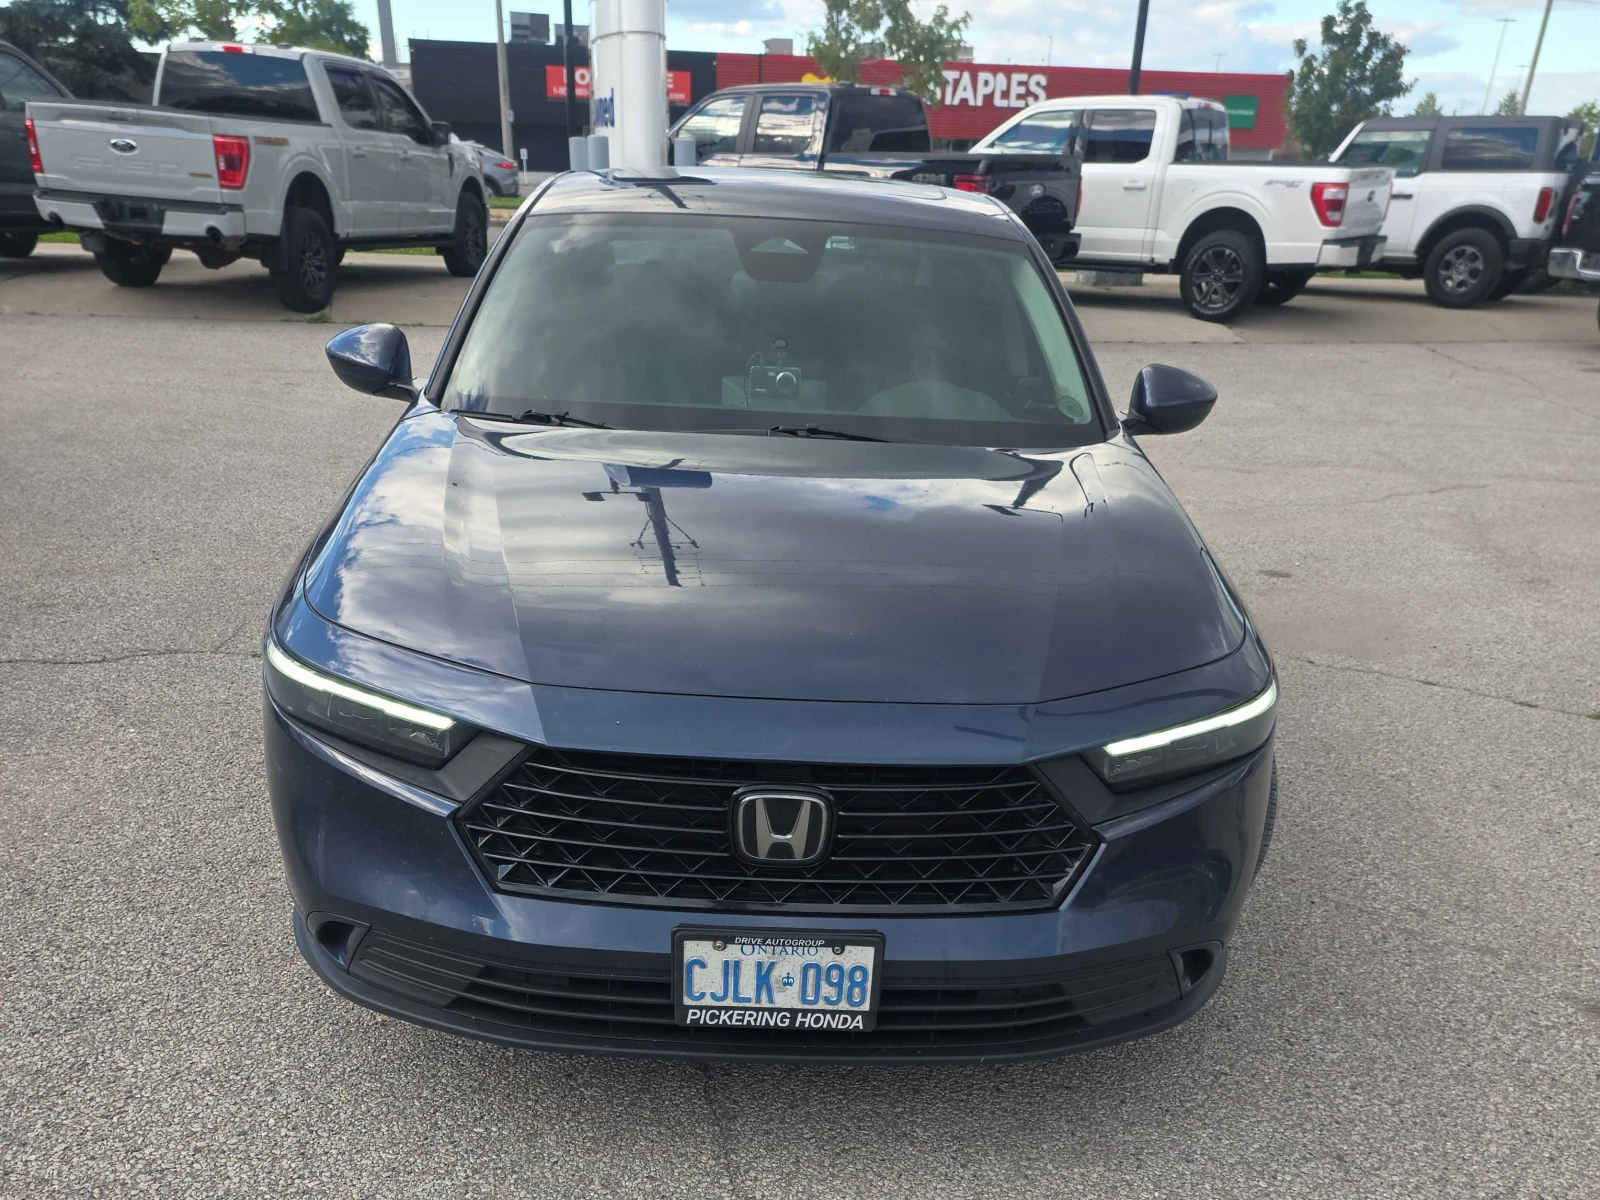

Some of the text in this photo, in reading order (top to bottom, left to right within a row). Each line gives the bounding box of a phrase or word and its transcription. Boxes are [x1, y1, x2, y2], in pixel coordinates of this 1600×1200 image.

[734, 937, 825, 947] DRIVE AUTOGROUP
[740, 944, 819, 957] ONTARIO
[685, 956, 869, 1008] CJLK 098
[686, 1009, 864, 1030] PICKERING HONDA
